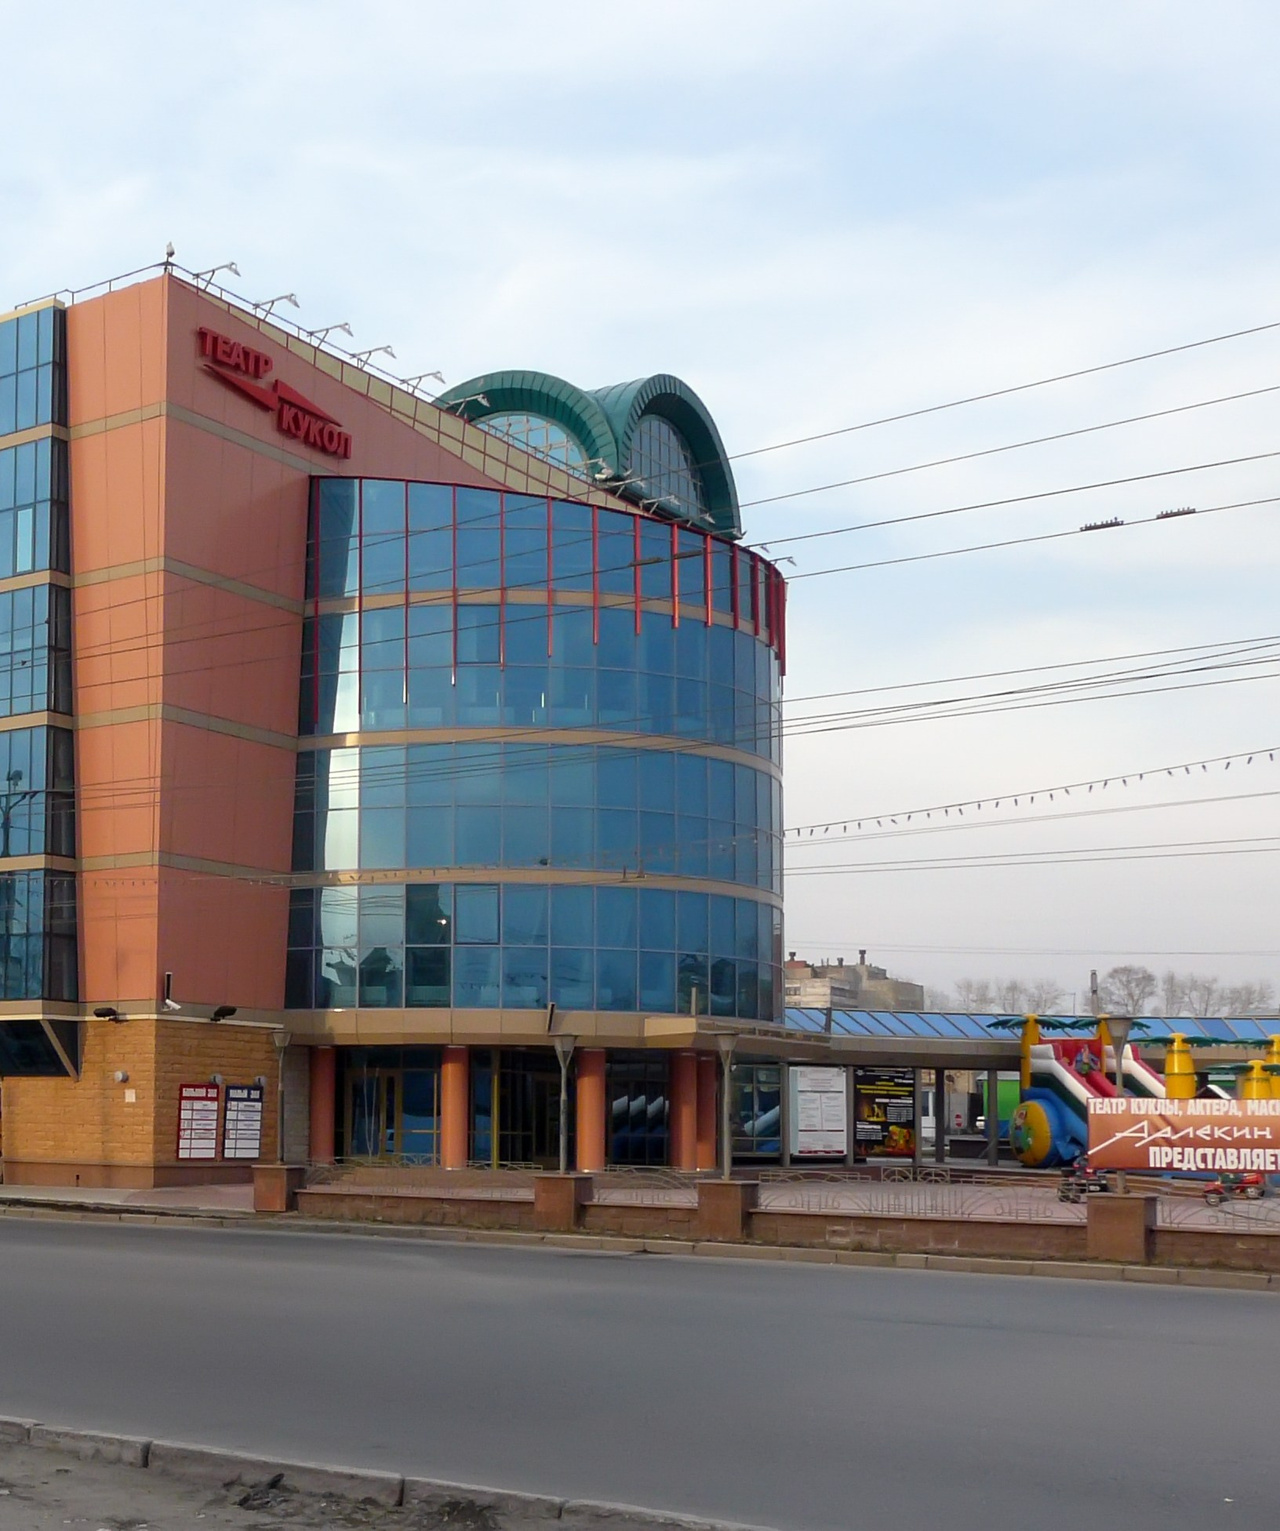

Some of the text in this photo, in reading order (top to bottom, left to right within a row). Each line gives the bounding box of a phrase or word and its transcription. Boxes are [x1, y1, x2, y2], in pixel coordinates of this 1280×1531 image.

[198, 327, 273, 379] ТЕАТР
[278, 403, 352, 459] КУКОЛ
[1088, 1099, 1280, 1118] ТЕАТР КУКЛЫ, АКТЕРА, МАС
